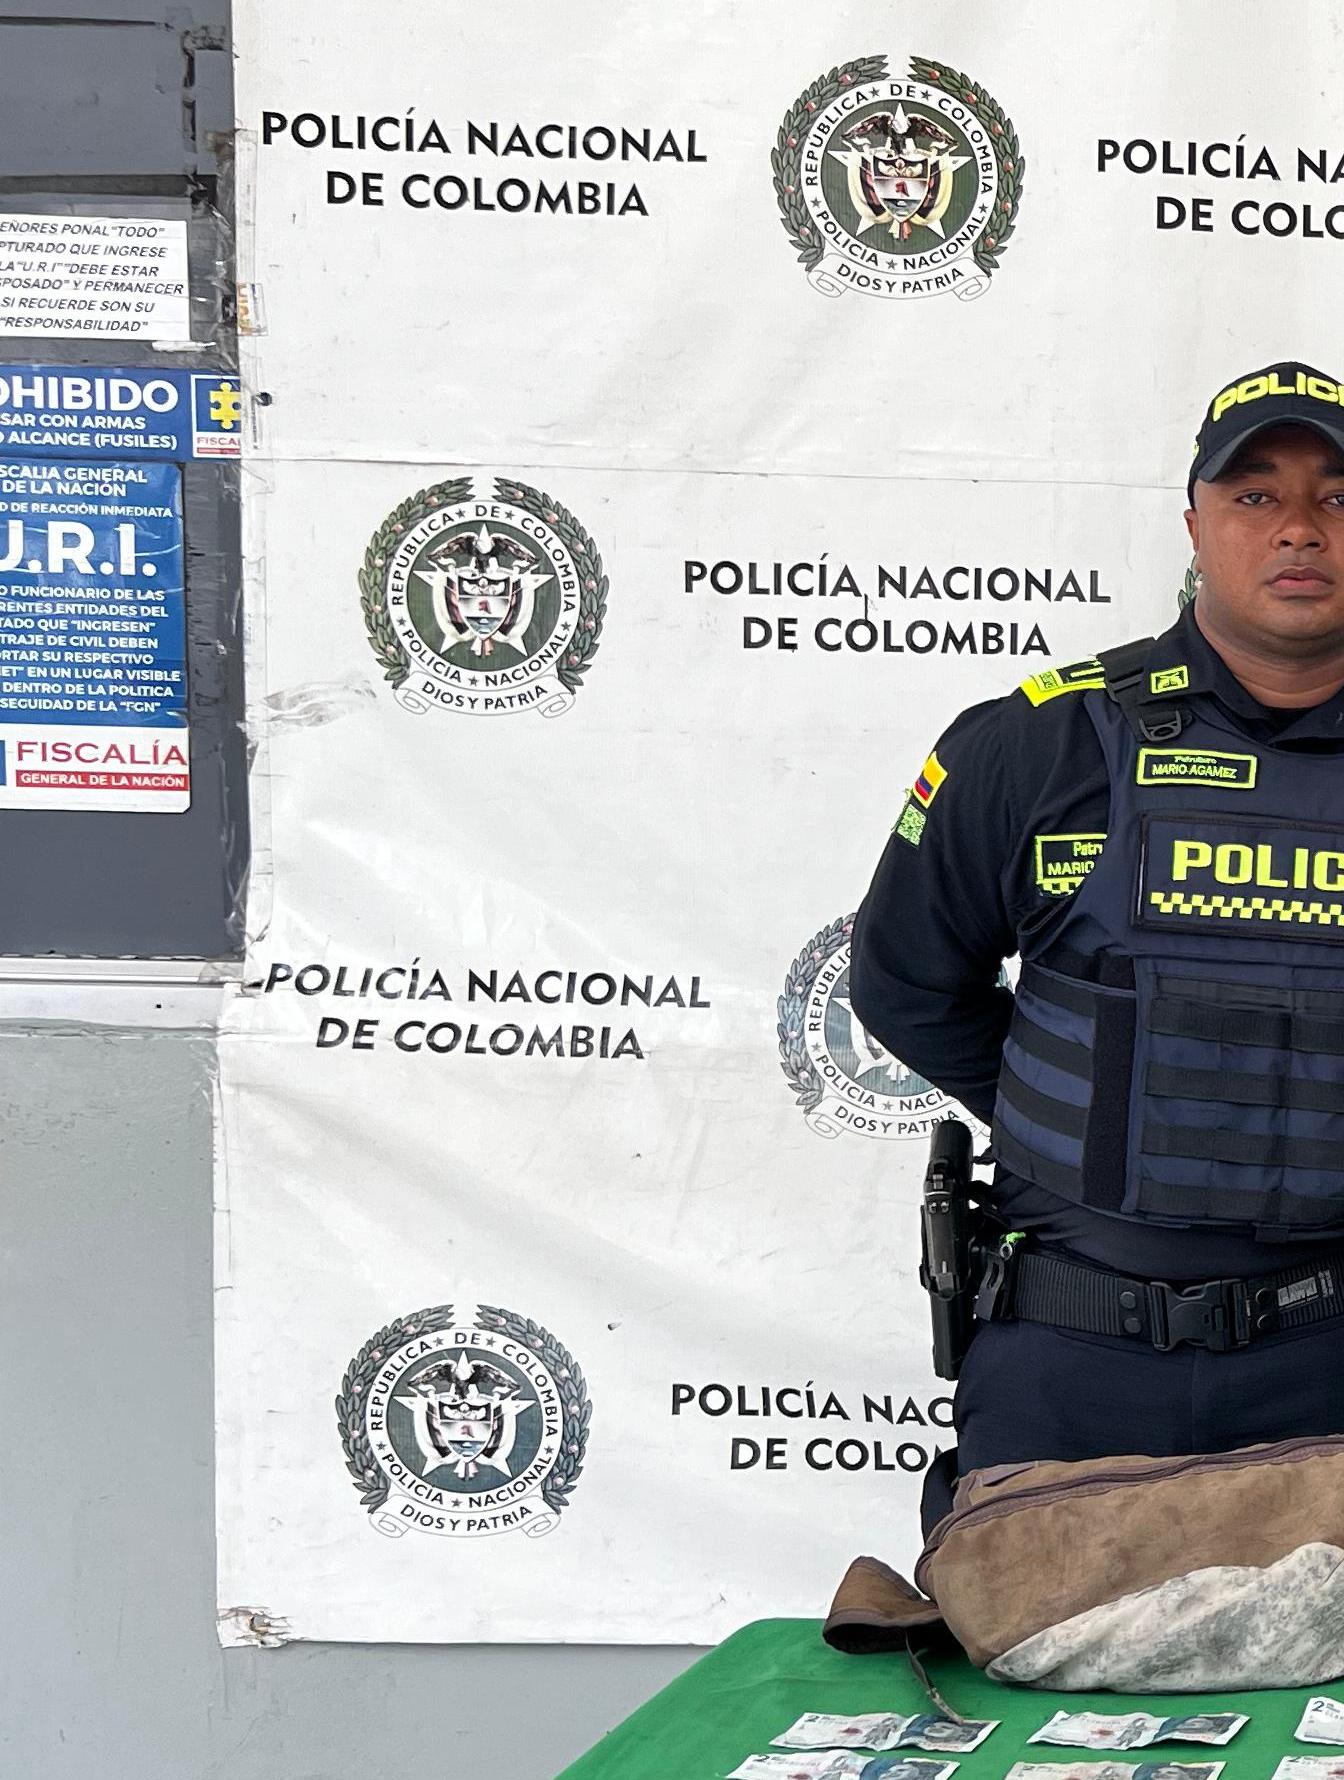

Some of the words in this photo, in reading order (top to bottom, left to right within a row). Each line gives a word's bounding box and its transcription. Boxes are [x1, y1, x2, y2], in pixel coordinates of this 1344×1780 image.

[262, 107, 452, 154] POLICÍA
[467, 121, 708, 163] NACIONAL
[889, 83, 917, 98] DE
[937, 98, 993, 194] COLOMBIA
[1097, 134, 1281, 181] POLICÍA
[326, 170, 384, 206] DE
[401, 173, 649, 217] COLOMBIA
[1155, 196, 1214, 233] DE
[0, 219, 58, 234] EÑORES
[61, 224, 109, 236] PONAL
[0, 241, 66, 254] PTURADO
[70, 244, 101, 255] QUE
[104, 246, 168, 258] INGRESE
[903, 214, 986, 270] NACIONAL
[112, 265, 159, 277] ESTAR
[837, 263, 881, 290] DIOS
[886, 281, 897, 293] Y
[902, 267, 964, 293] PATRIA
[73, 280, 82, 290] Y
[84, 281, 184, 295] PERMANECER
[18, 297, 97, 310] RECUERDE
[100, 300, 130, 312] SON
[134, 302, 155, 313] SU
[0, 376, 178, 413] HIBIDO
[39, 414, 78, 428] CON
[82, 416, 146, 430] ARMAS
[7, 431, 91, 446] ALCANCE
[95, 434, 177, 450] (FUSILES)
[197, 437, 241, 447] FISCA
[0, 465, 60, 480] SCALIA
[64, 467, 148, 483] GENERAL
[3, 480, 26, 493] DE
[31, 481, 53, 494] LA
[57, 481, 126, 497] NACIÓN
[11, 502, 28, 512] DE
[31, 502, 98, 515] REACCIÓN
[100, 506, 174, 518] INMEDIATA
[475, 504, 500, 518] DE
[520, 518, 576, 612] COLOMBIA
[684, 553, 862, 599] POLICÍA
[878, 564, 1111, 603] NACIONAL
[11, 586, 111, 599] FUNCIONARIO
[114, 589, 134, 600] DE
[136, 590, 165, 601] LAS
[0, 602, 53, 614] RENTES
[55, 603, 138, 616] ENTIDADES
[140, 606, 168, 617] DEL
[0, 619, 34, 630] TADO
[38, 619, 69, 632] QUE
[743, 616, 798, 653] DE
[814, 617, 1051, 656] COLOMBIA
[1, 634, 44, 645] TRAJE
[47, 635, 67, 646] DE
[69, 636, 107, 648] CIVIL
[108, 637, 158, 649] DEBEN
[1, 650, 39, 662] RTAR
[42, 651, 61, 662] SU
[64, 652, 154, 665] RESPECTIVO
[485, 634, 568, 687] NACIONAL
[27, 666, 47, 678] EN
[50, 667, 72, 678] UN
[75, 668, 123, 680] LUGAR
[126, 670, 181, 682] VISIBLE
[2, 682, 62, 694] DENTRO
[65, 683, 85, 695] DE
[88, 684, 107, 695] LA
[421, 681, 465, 708] DIOS
[468, 698, 479, 711] Y
[484, 684, 548, 710] PATRIA
[76, 700, 96, 711] DE
[99, 700, 118, 712] LA
[16, 739, 188, 766] FISCALÍA
[20, 773, 87, 786] GENERAL
[89, 775, 108, 786] DE
[111, 776, 129, 786] LA
[132, 775, 185, 787] NACIÓN
[262, 957, 453, 1001] POLICÍA
[468, 968, 711, 1008] NACIONAL
[316, 1016, 380, 1050] DE
[393, 1020, 645, 1060] COLOMBIA
[454, 1332, 481, 1345] DE
[503, 1344, 559, 1437] COLOMBIA
[671, 1380, 851, 1421] POLICÍA
[730, 1437, 788, 1470] DE
[804, 1437, 946, 1474] COLO
[468, 1456, 552, 1508] NACIONAL
[400, 1503, 446, 1530] DIOS
[449, 1518, 461, 1531] Y
[466, 1506, 533, 1532] PATRIA
[1311, 1701, 1325, 1712] 2
